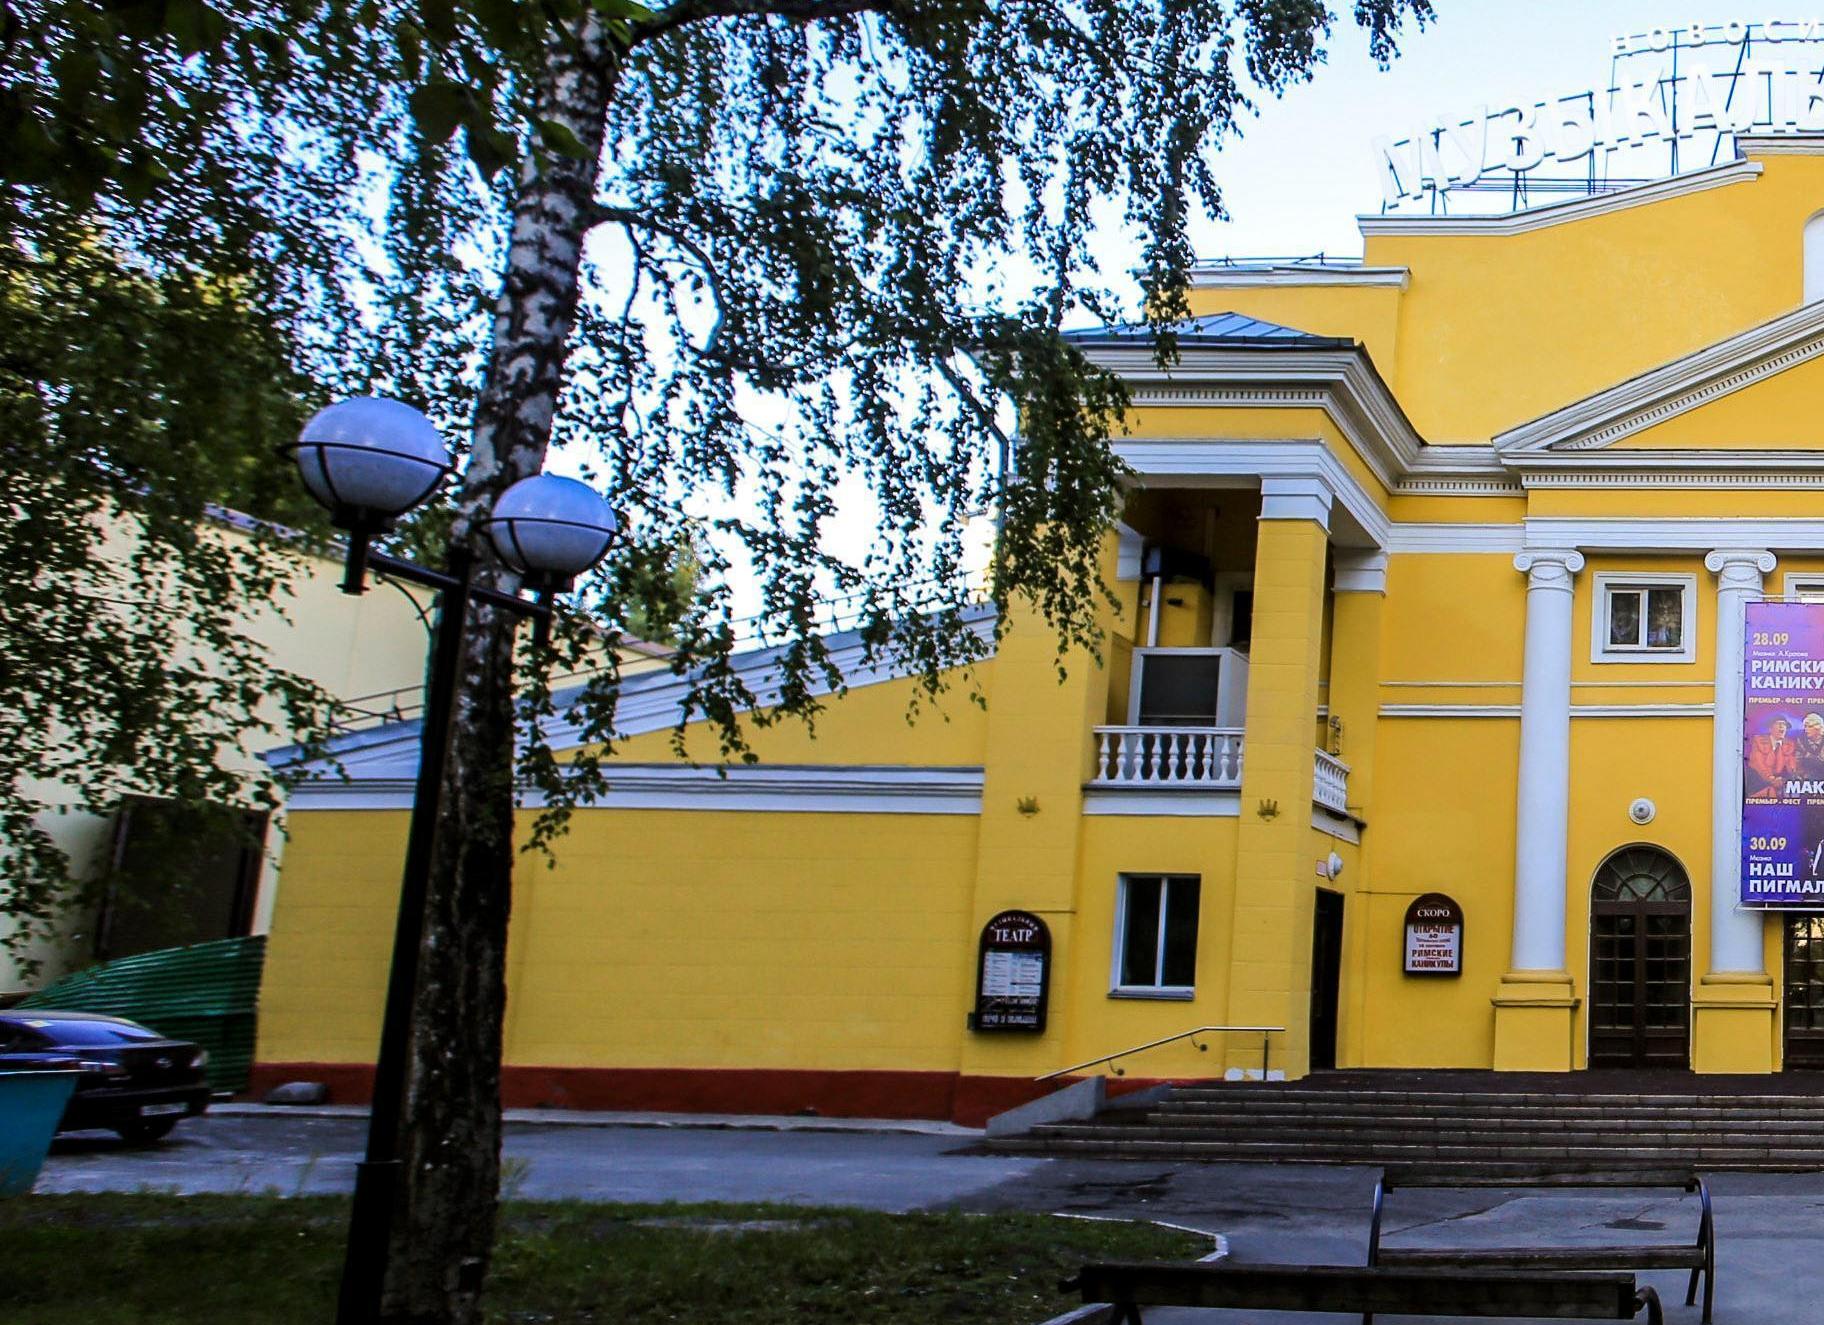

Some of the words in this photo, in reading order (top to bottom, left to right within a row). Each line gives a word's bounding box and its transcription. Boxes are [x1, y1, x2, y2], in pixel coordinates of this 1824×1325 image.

[1753, 633, 1788, 645] 28.09
[1750, 837, 1787, 850] 30.09
[1750, 863, 1793, 876] НАШ
[1417, 909, 1450, 917] СКОРО
[994, 929, 1033, 942] ТЕАТР
